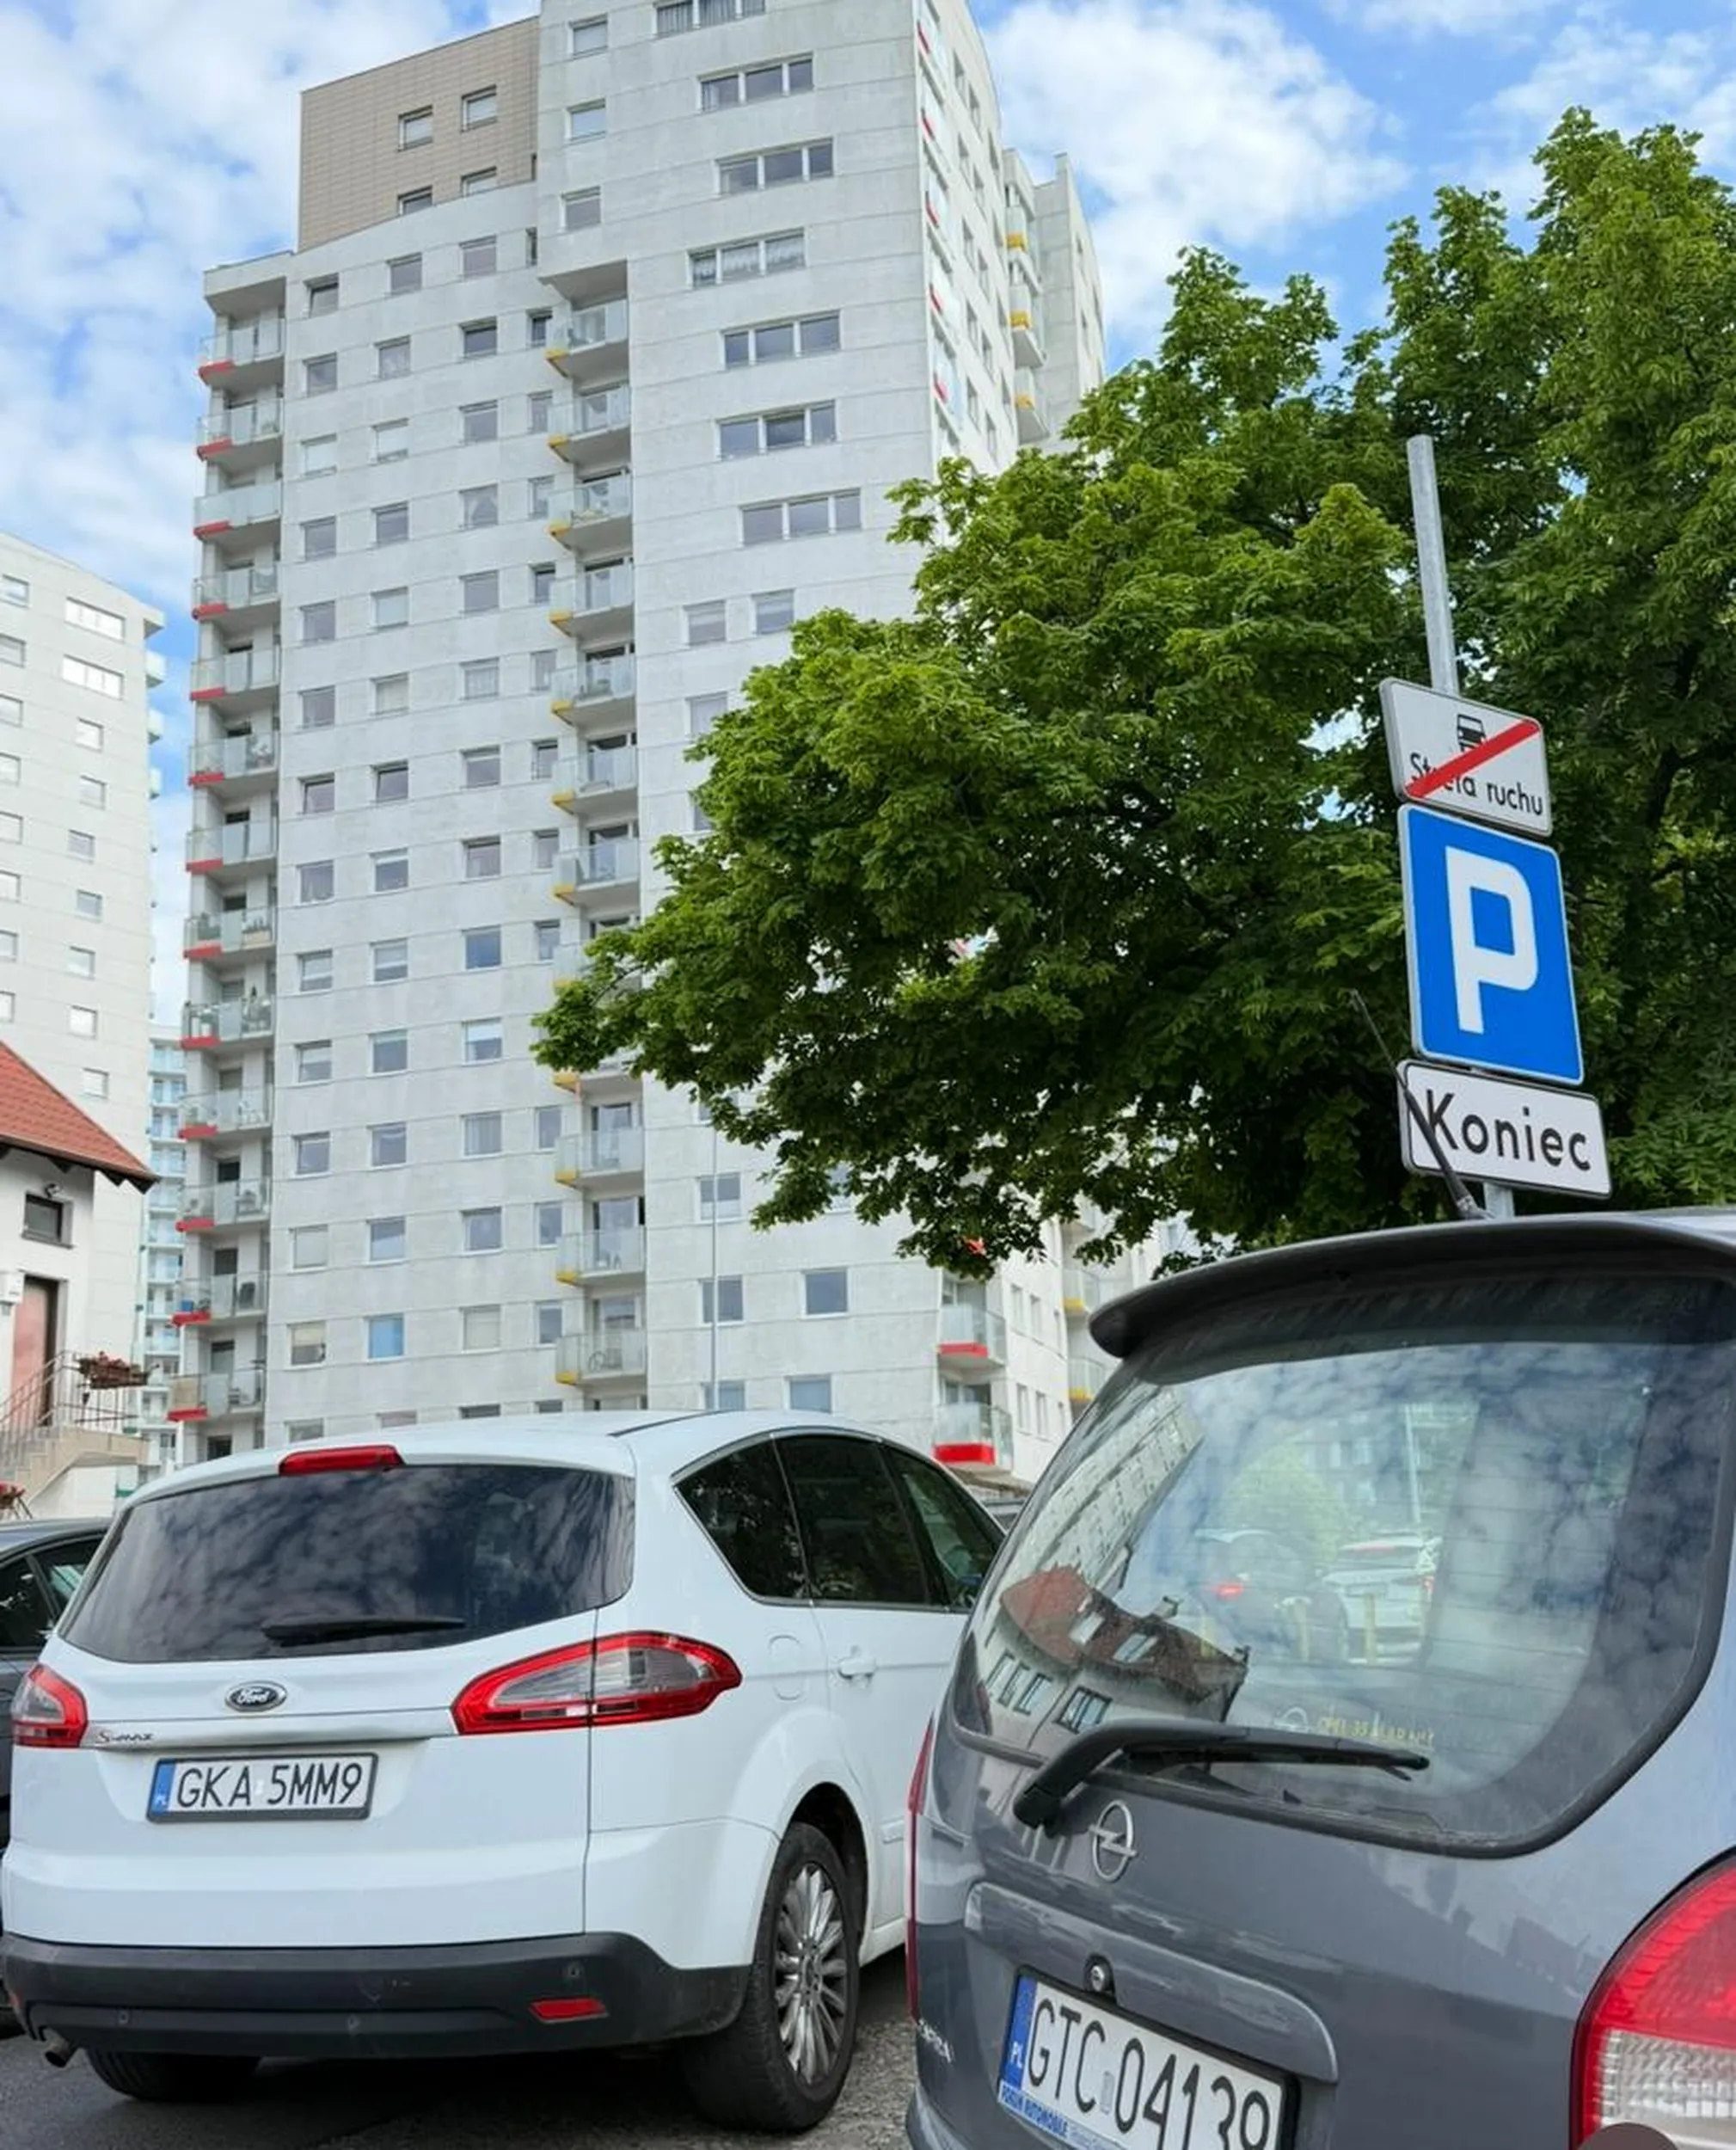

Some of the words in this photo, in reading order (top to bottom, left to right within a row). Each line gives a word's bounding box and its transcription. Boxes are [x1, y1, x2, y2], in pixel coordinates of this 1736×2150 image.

[1487, 782, 1544, 816] ruchu
[1445, 845, 1539, 1035] P
[1427, 1088, 1592, 1172] Koniec
[237, 1686, 270, 1705] Ford
[177, 1766, 251, 1808] GKA
[267, 1762, 363, 1806] 5MM9
[1010, 2041, 1024, 2069] PL
[1028, 1998, 1106, 2114] GTC
[1115, 2037, 1271, 2150] 04139
